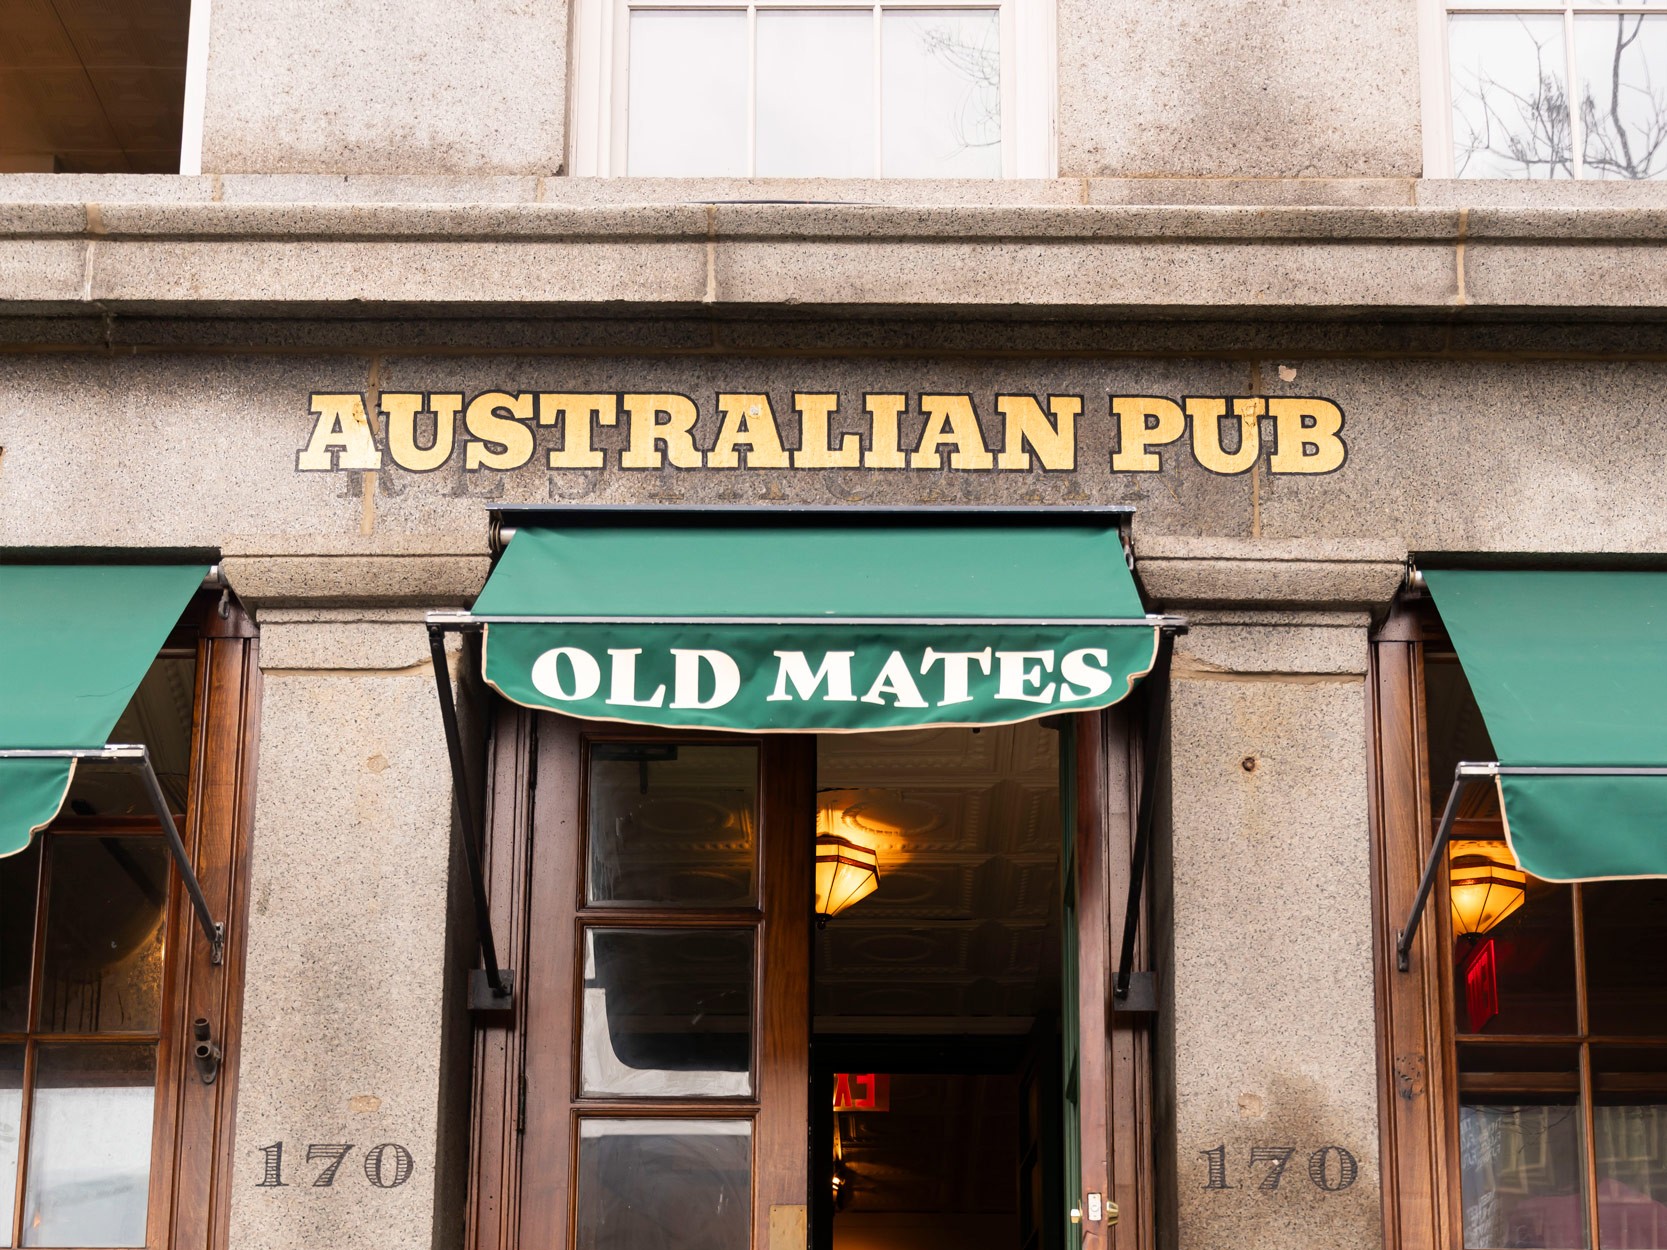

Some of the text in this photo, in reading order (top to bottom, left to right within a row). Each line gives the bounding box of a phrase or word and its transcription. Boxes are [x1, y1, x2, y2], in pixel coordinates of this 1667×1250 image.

[296, 389, 1348, 475] AUSTRALIAN PUB
[531, 647, 1112, 710] OLD MATES
[255, 1141, 413, 1188] 170
[1199, 1144, 1358, 1191] 170
